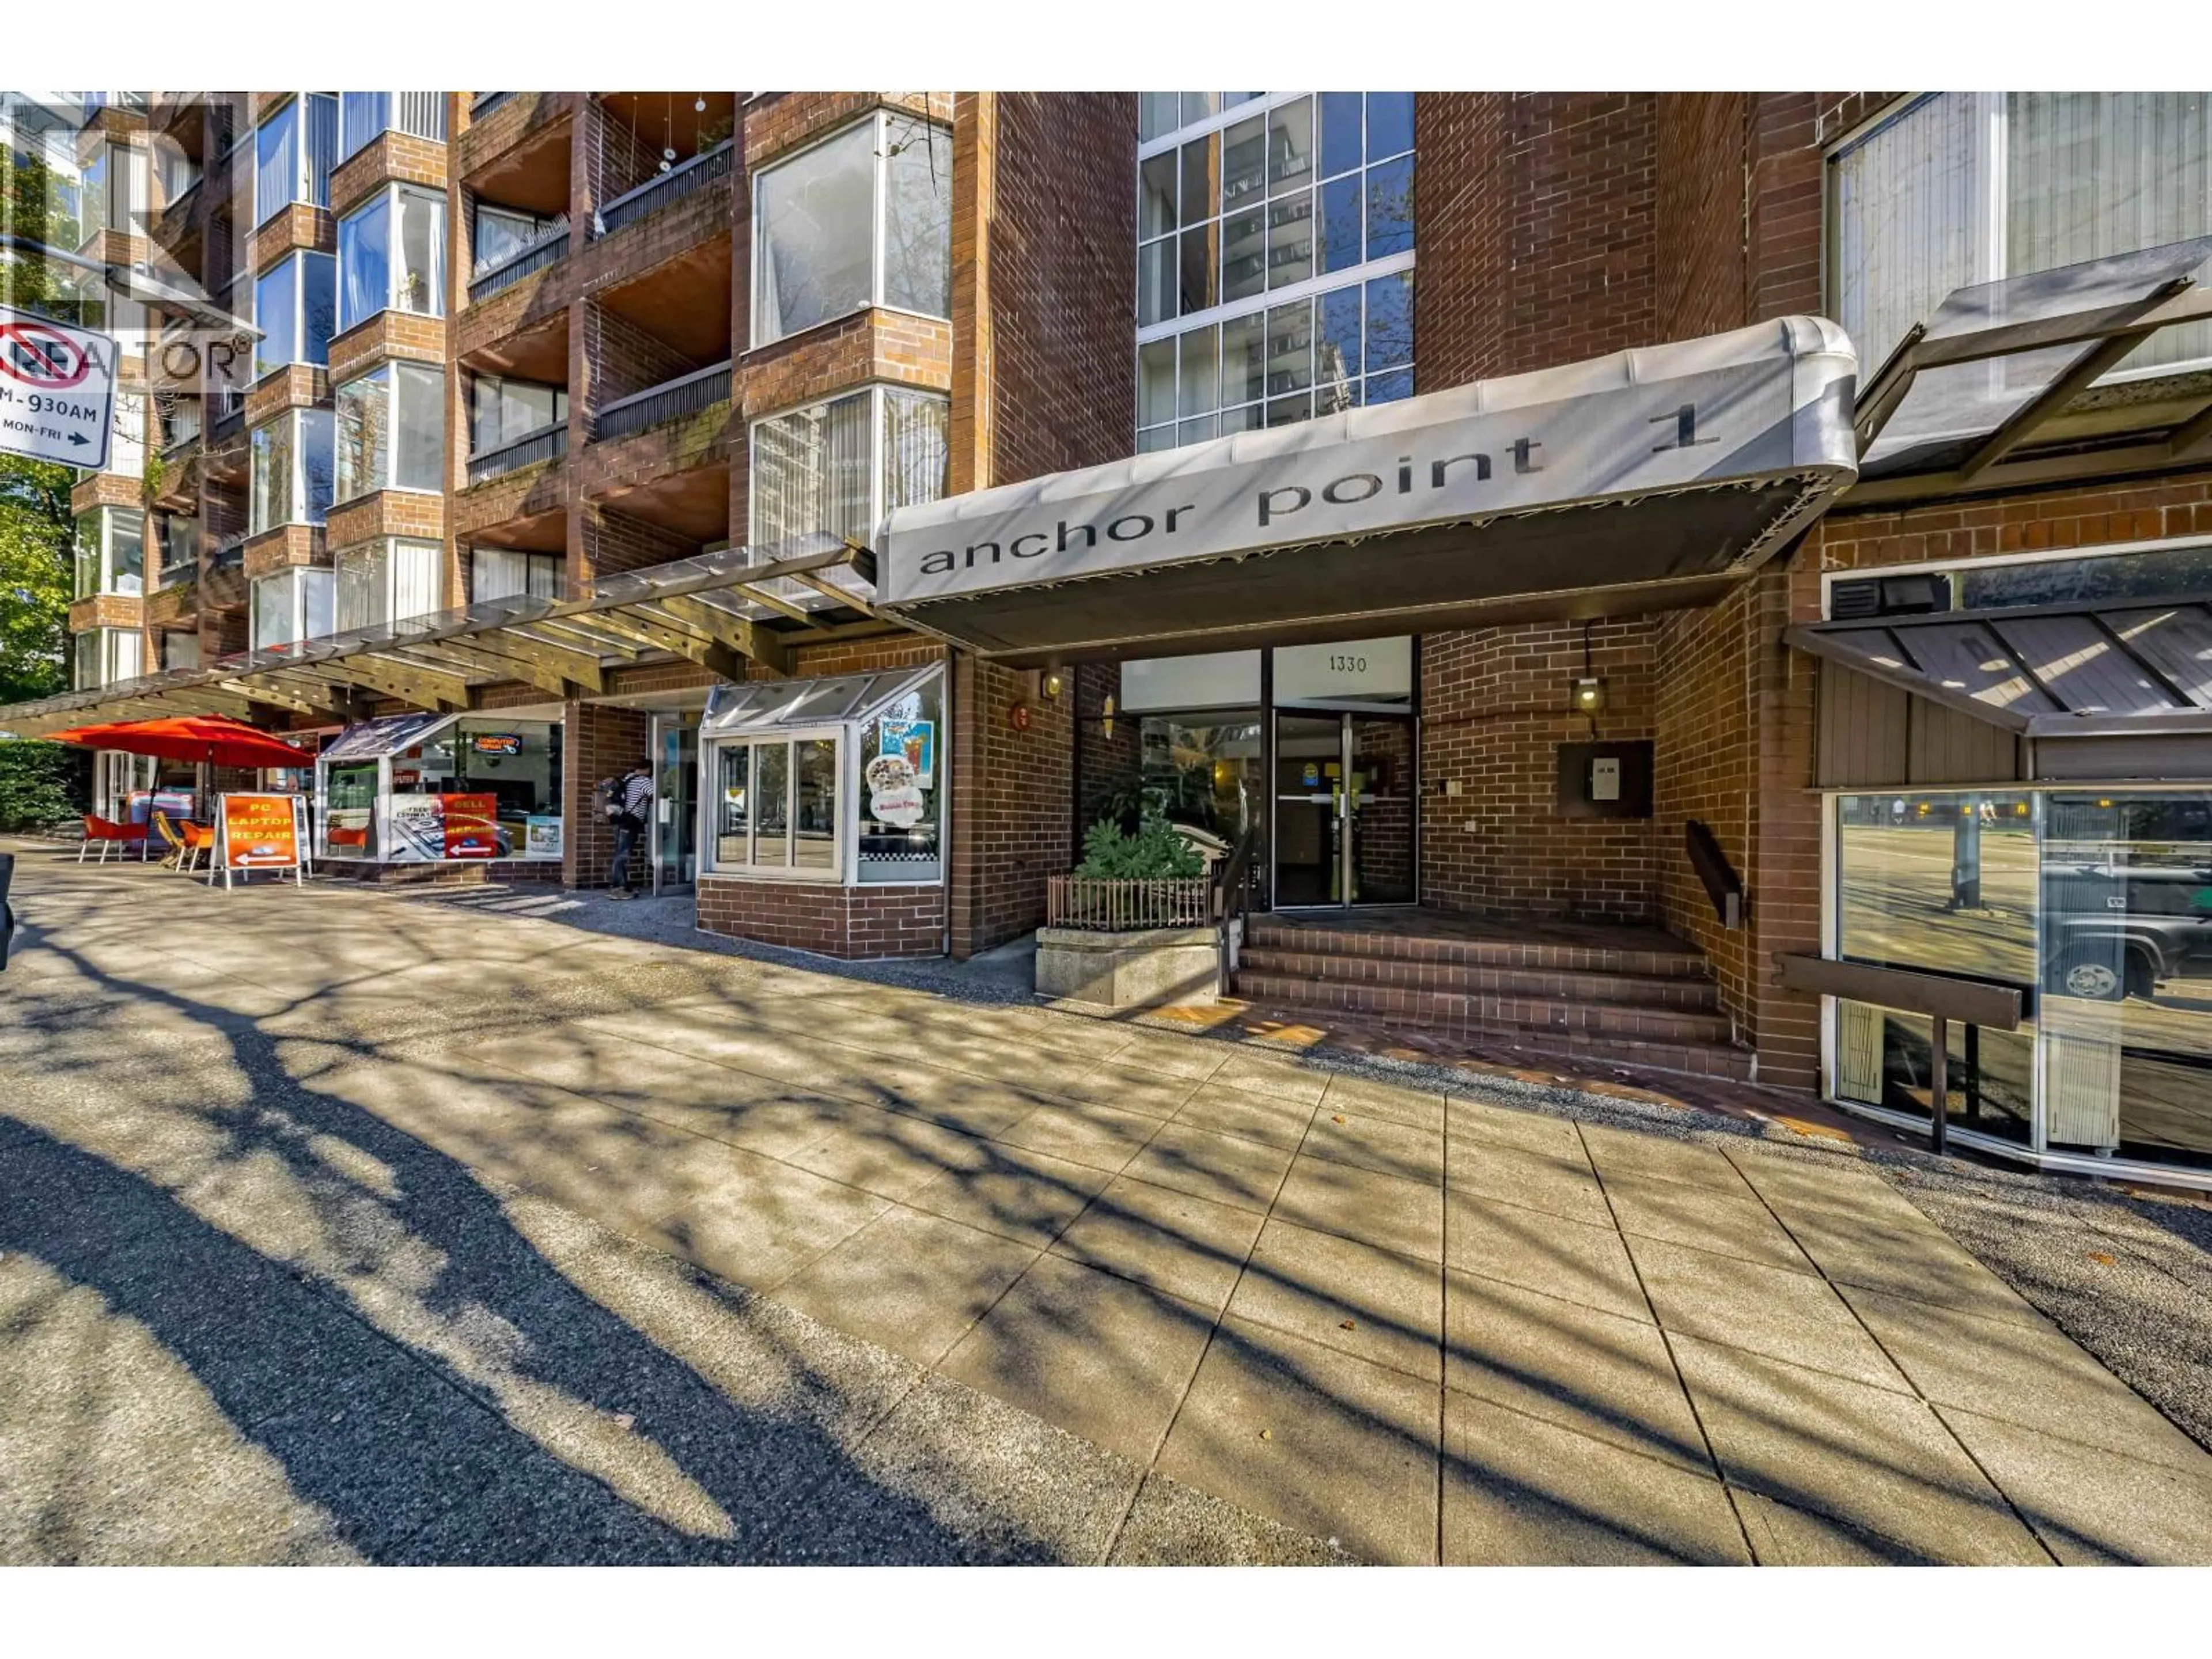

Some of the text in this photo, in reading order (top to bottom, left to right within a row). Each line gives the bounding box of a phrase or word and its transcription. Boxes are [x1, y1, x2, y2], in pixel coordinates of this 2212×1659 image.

[3, 419, 60, 440] MON-FRI
[920, 403, 1721, 575] anchor point 1
[1330, 654, 1367, 673] 1330
[250, 803, 271, 812] PC
[454, 800, 486, 808] CELL
[228, 817, 291, 825] LAPTOP
[231, 831, 291, 839] REPAIR
